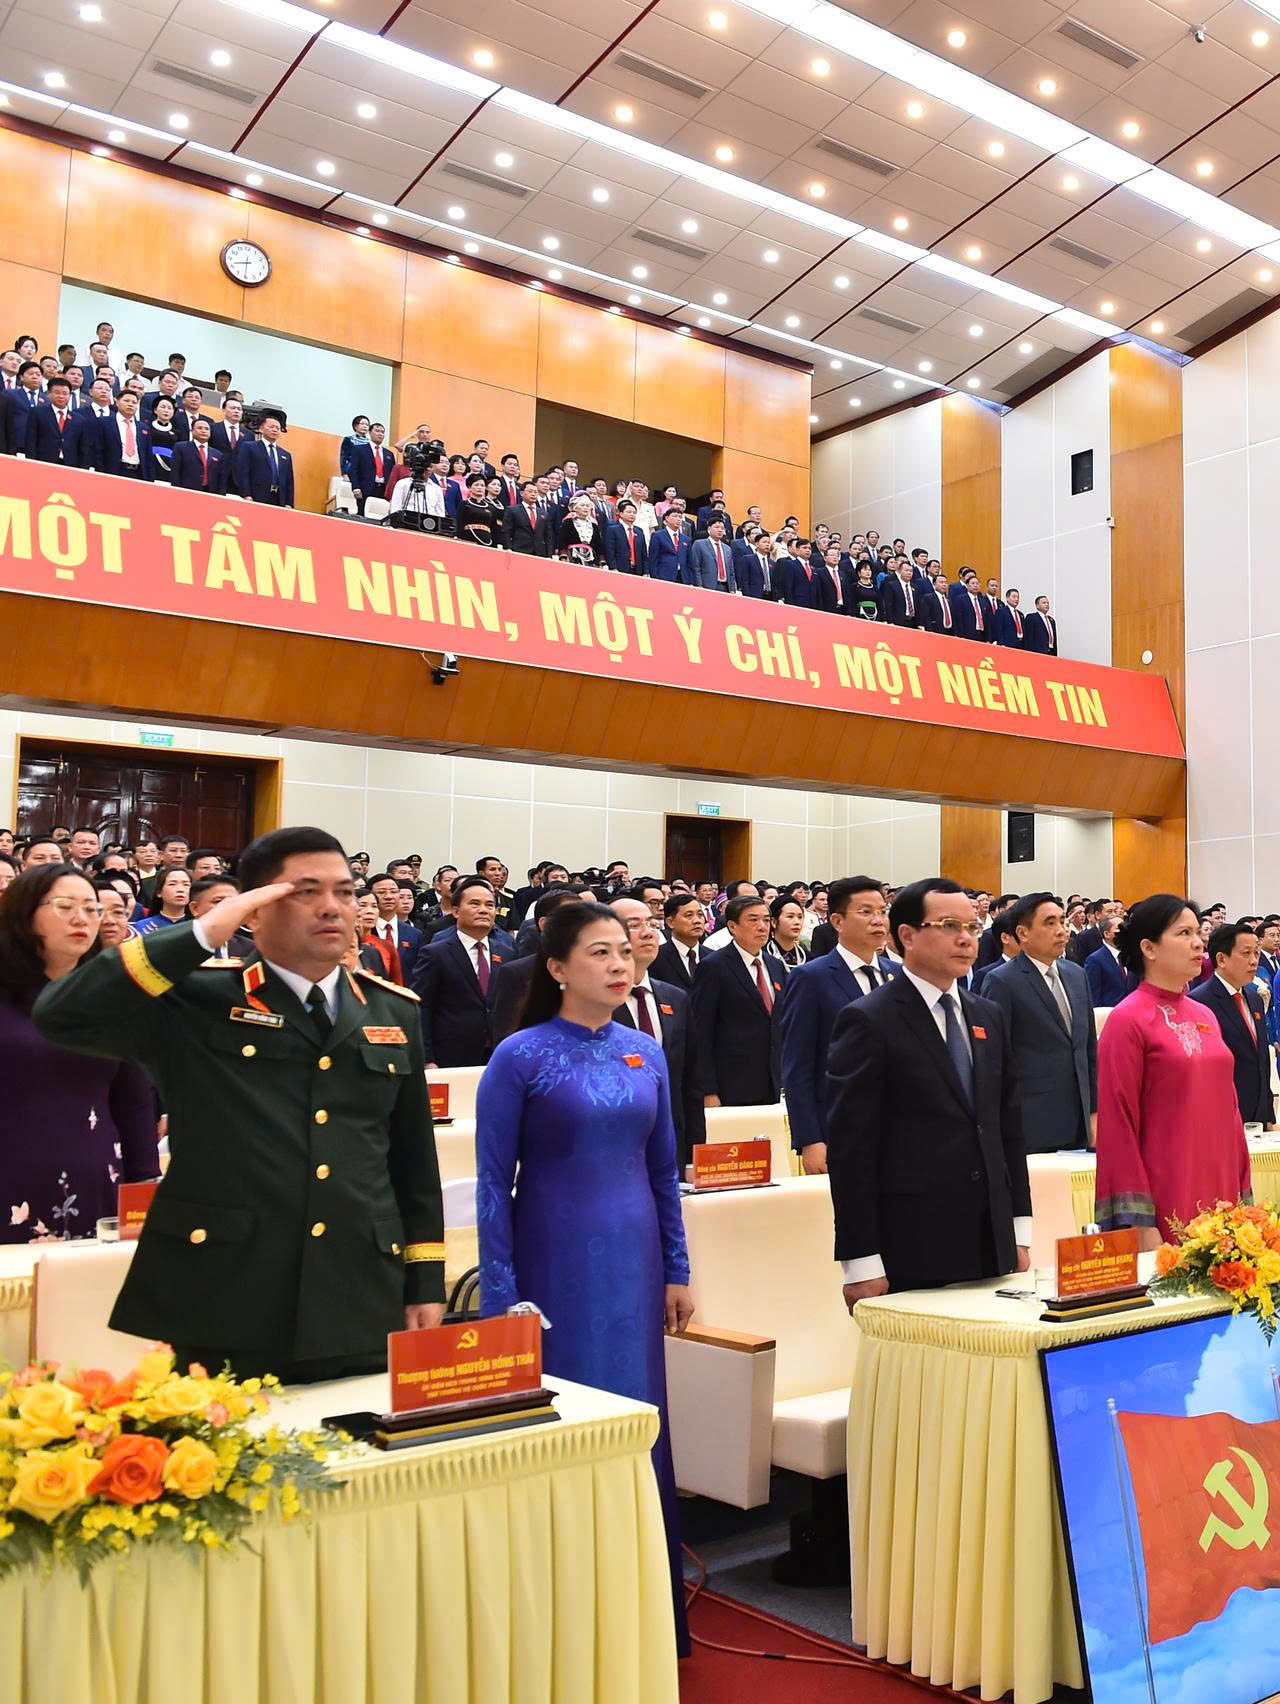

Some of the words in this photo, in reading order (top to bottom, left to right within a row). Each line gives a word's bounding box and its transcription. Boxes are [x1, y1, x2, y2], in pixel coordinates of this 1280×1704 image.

[160, 513, 319, 606] TẦM
[343, 555, 521, 643] NHÌN,
[538, 588, 657, 665] MỘT
[674, 607, 704, 665] Ý
[724, 624, 823, 690] CHÍ,
[832, 641, 924, 706] MỘT
[936, 656, 1041, 718] NIỀM
[1045, 681, 1109, 728] TIN
